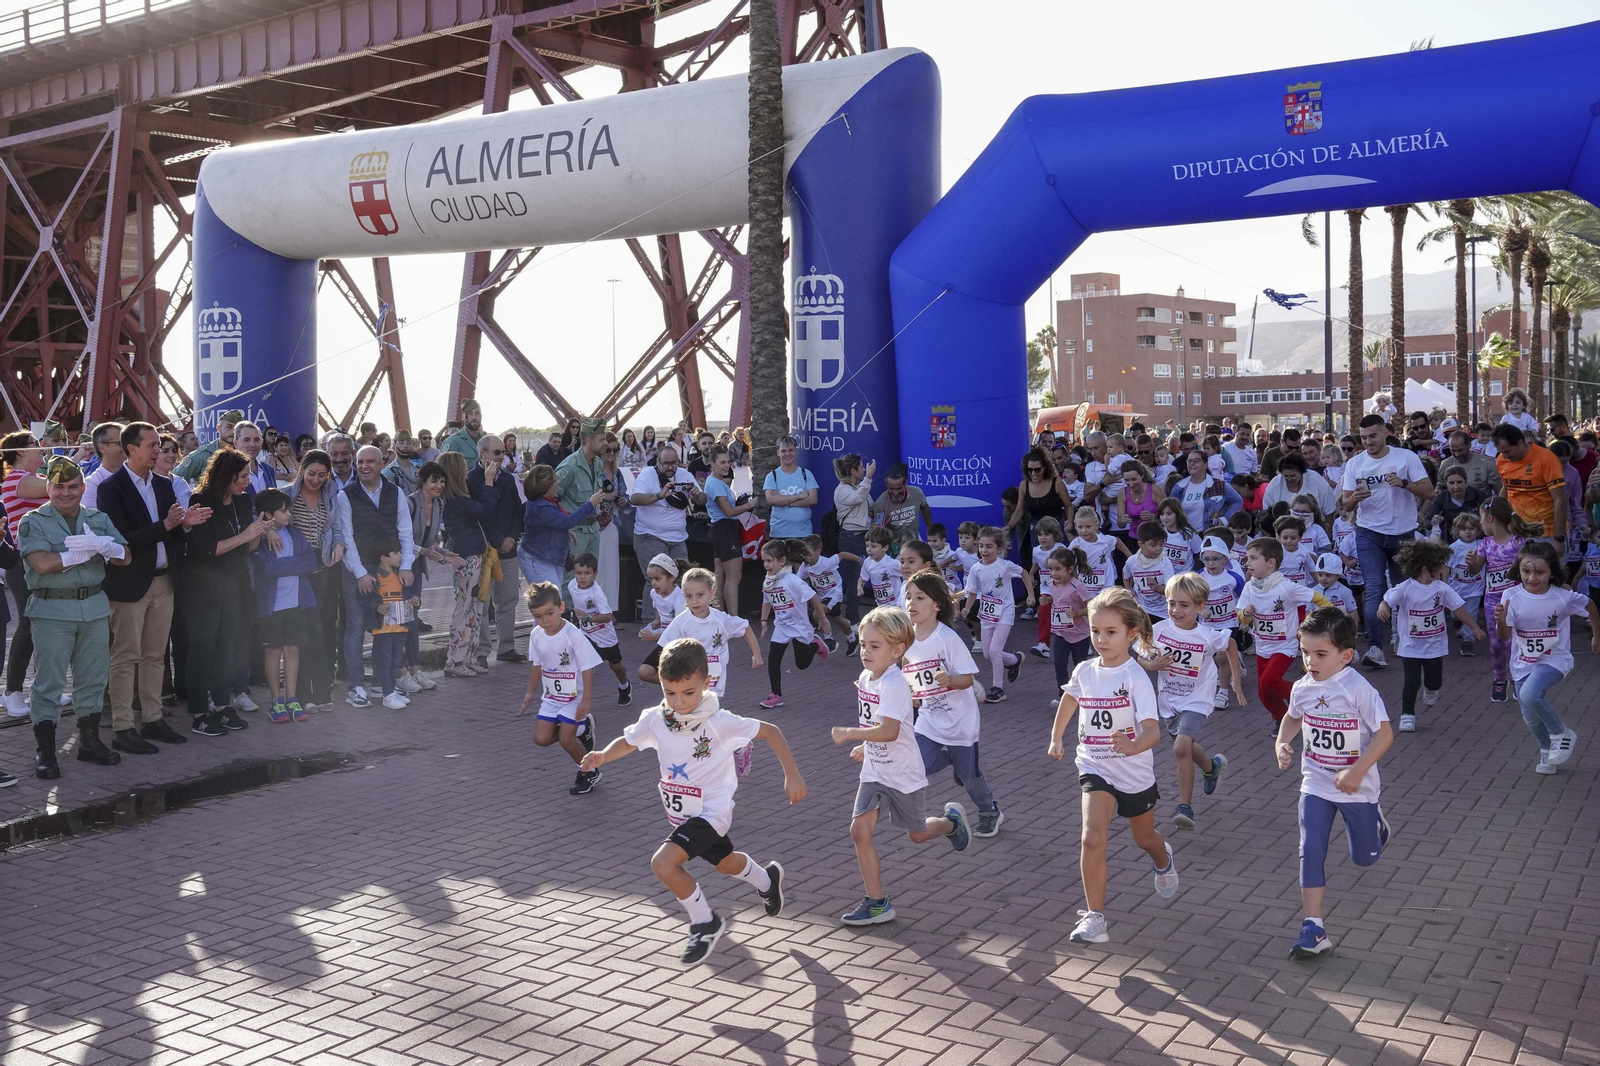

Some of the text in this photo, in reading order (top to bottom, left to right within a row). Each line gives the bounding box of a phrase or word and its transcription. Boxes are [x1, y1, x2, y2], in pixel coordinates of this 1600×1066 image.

[425, 117, 620, 189] ALMERÍA
[1172, 127, 1449, 180] DIPUTACIÓN DE ALMERÍA
[430, 191, 528, 225] CIUDAD
[908, 455, 992, 471] DIPUTACIÓN
[909, 470, 991, 486] DE ALMERÍA
[900, 509, 916, 520] AÑOS
[1166, 548, 1182, 559] 185
[1590, 562, 1600, 571] 15
[816, 576, 830, 586] 153
[1082, 575, 1099, 585] 280
[771, 592, 787, 604] 216
[981, 602, 995, 614] 126
[1210, 603, 1228, 616] 107
[1259, 620, 1274, 632] 25
[1424, 615, 1438, 628] 56
[1527, 638, 1545, 653] 55
[1163, 646, 1192, 665] 202
[914, 667, 941, 687] 19
[554, 679, 562, 692] 6
[1091, 710, 1113, 730] 49
[1311, 728, 1346, 751] 250
[662, 791, 683, 813] 35
